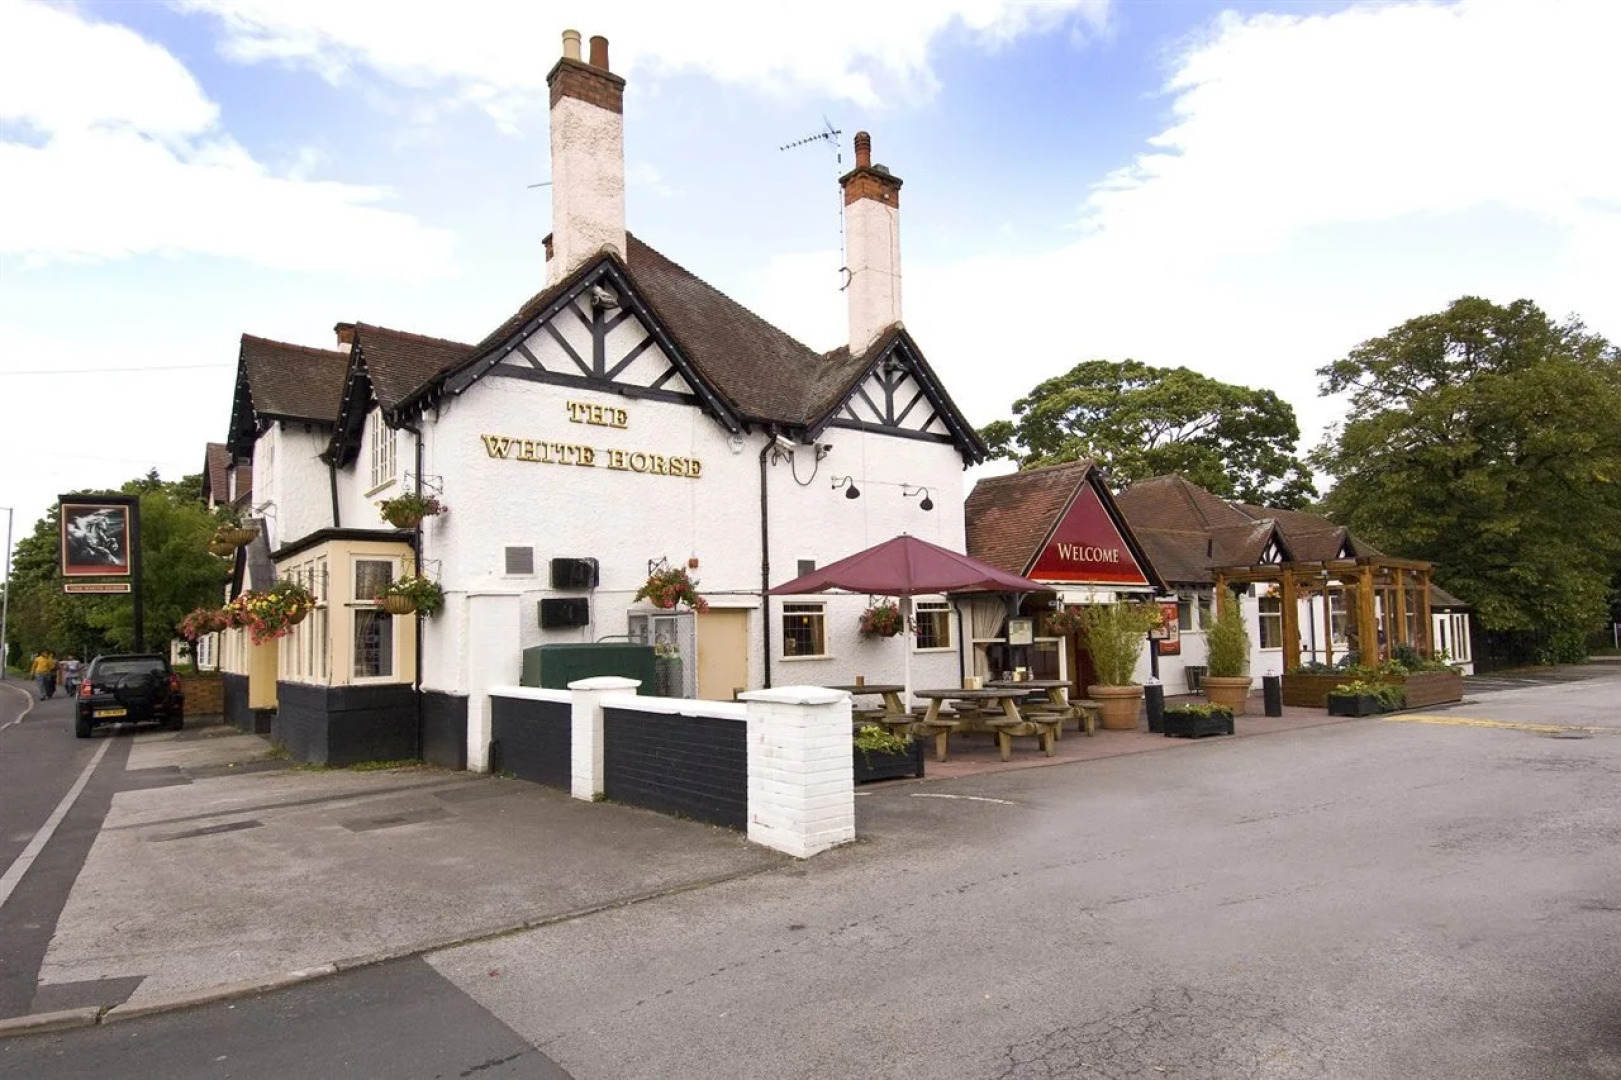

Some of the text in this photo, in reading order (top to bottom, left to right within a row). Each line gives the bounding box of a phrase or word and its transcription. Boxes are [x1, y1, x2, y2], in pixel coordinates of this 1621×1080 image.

[567, 400, 628, 429] THE
[481, 434, 702, 478] WHITE HORSE
[1057, 542, 1119, 563] WELCOME
